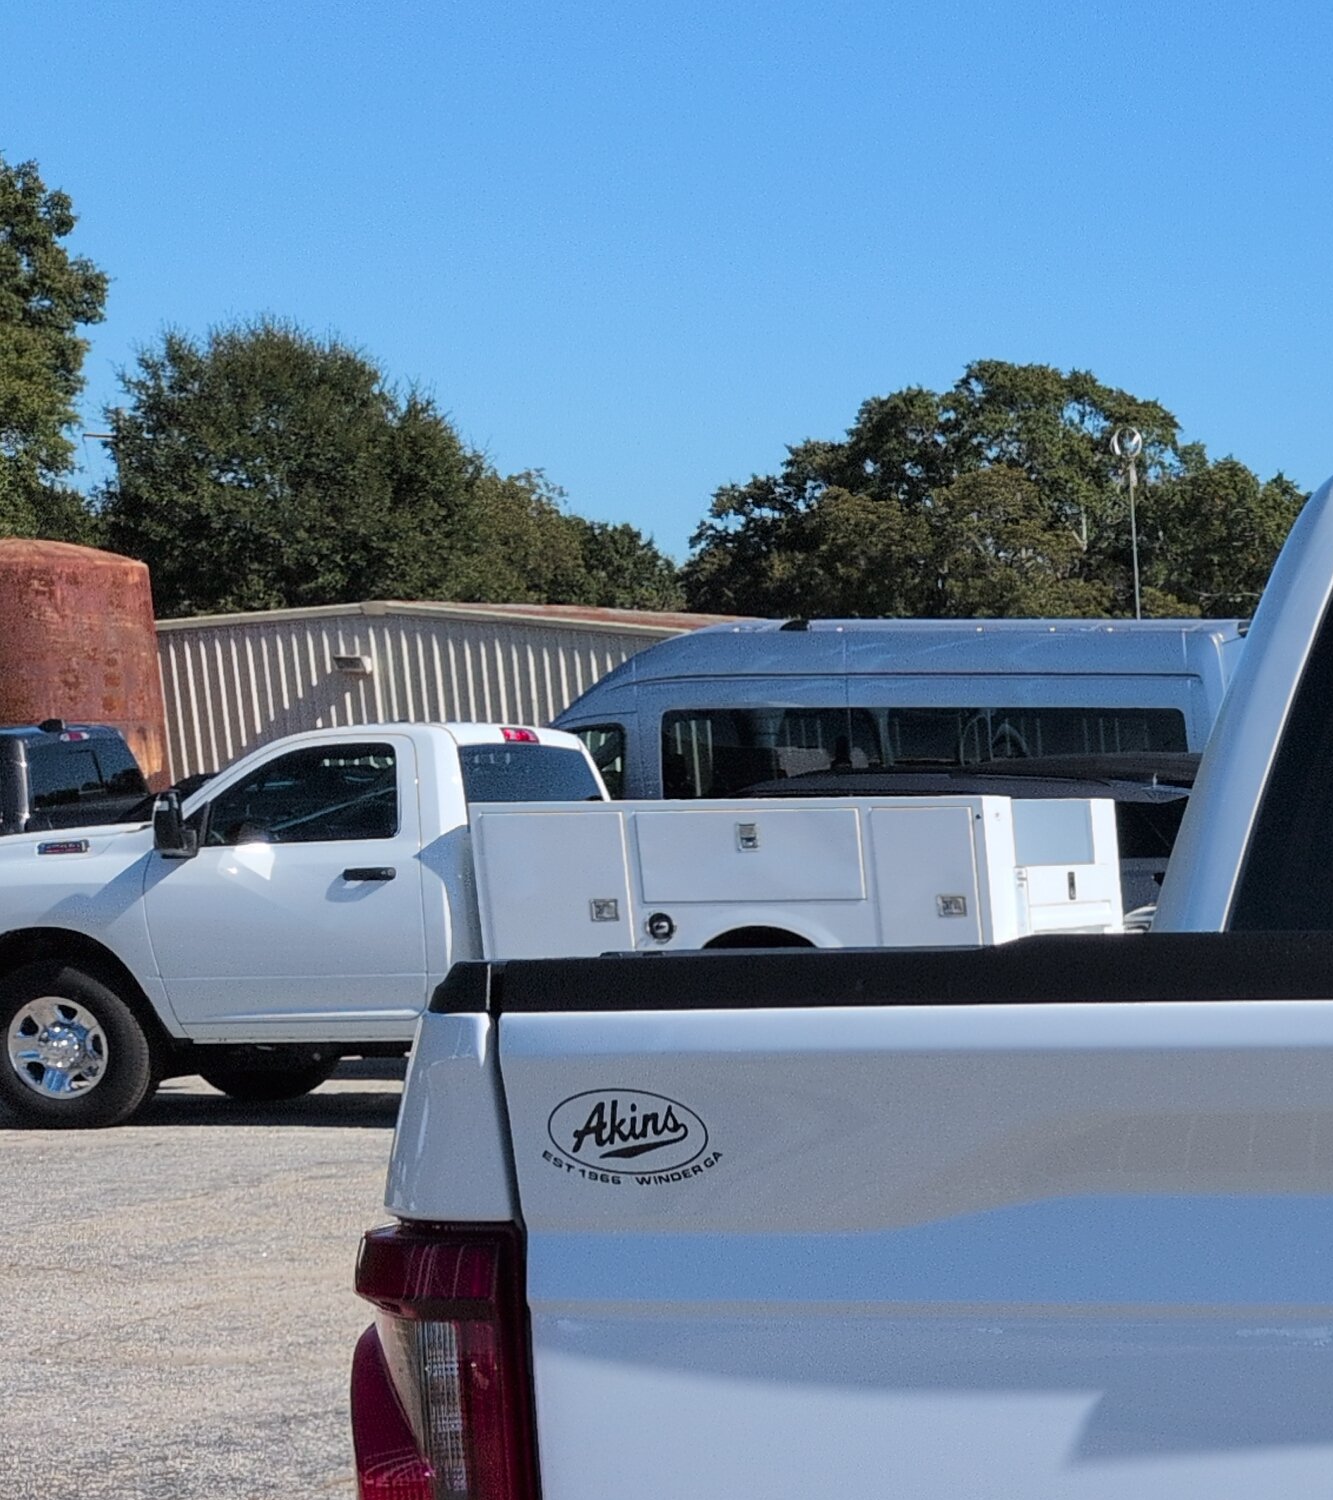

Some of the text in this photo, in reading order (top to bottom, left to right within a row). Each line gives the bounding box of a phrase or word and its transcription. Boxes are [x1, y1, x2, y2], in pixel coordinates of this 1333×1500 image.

[572, 1100, 688, 1158] Akins
[541, 1150, 723, 1185] EST 1966 WINDER GA
